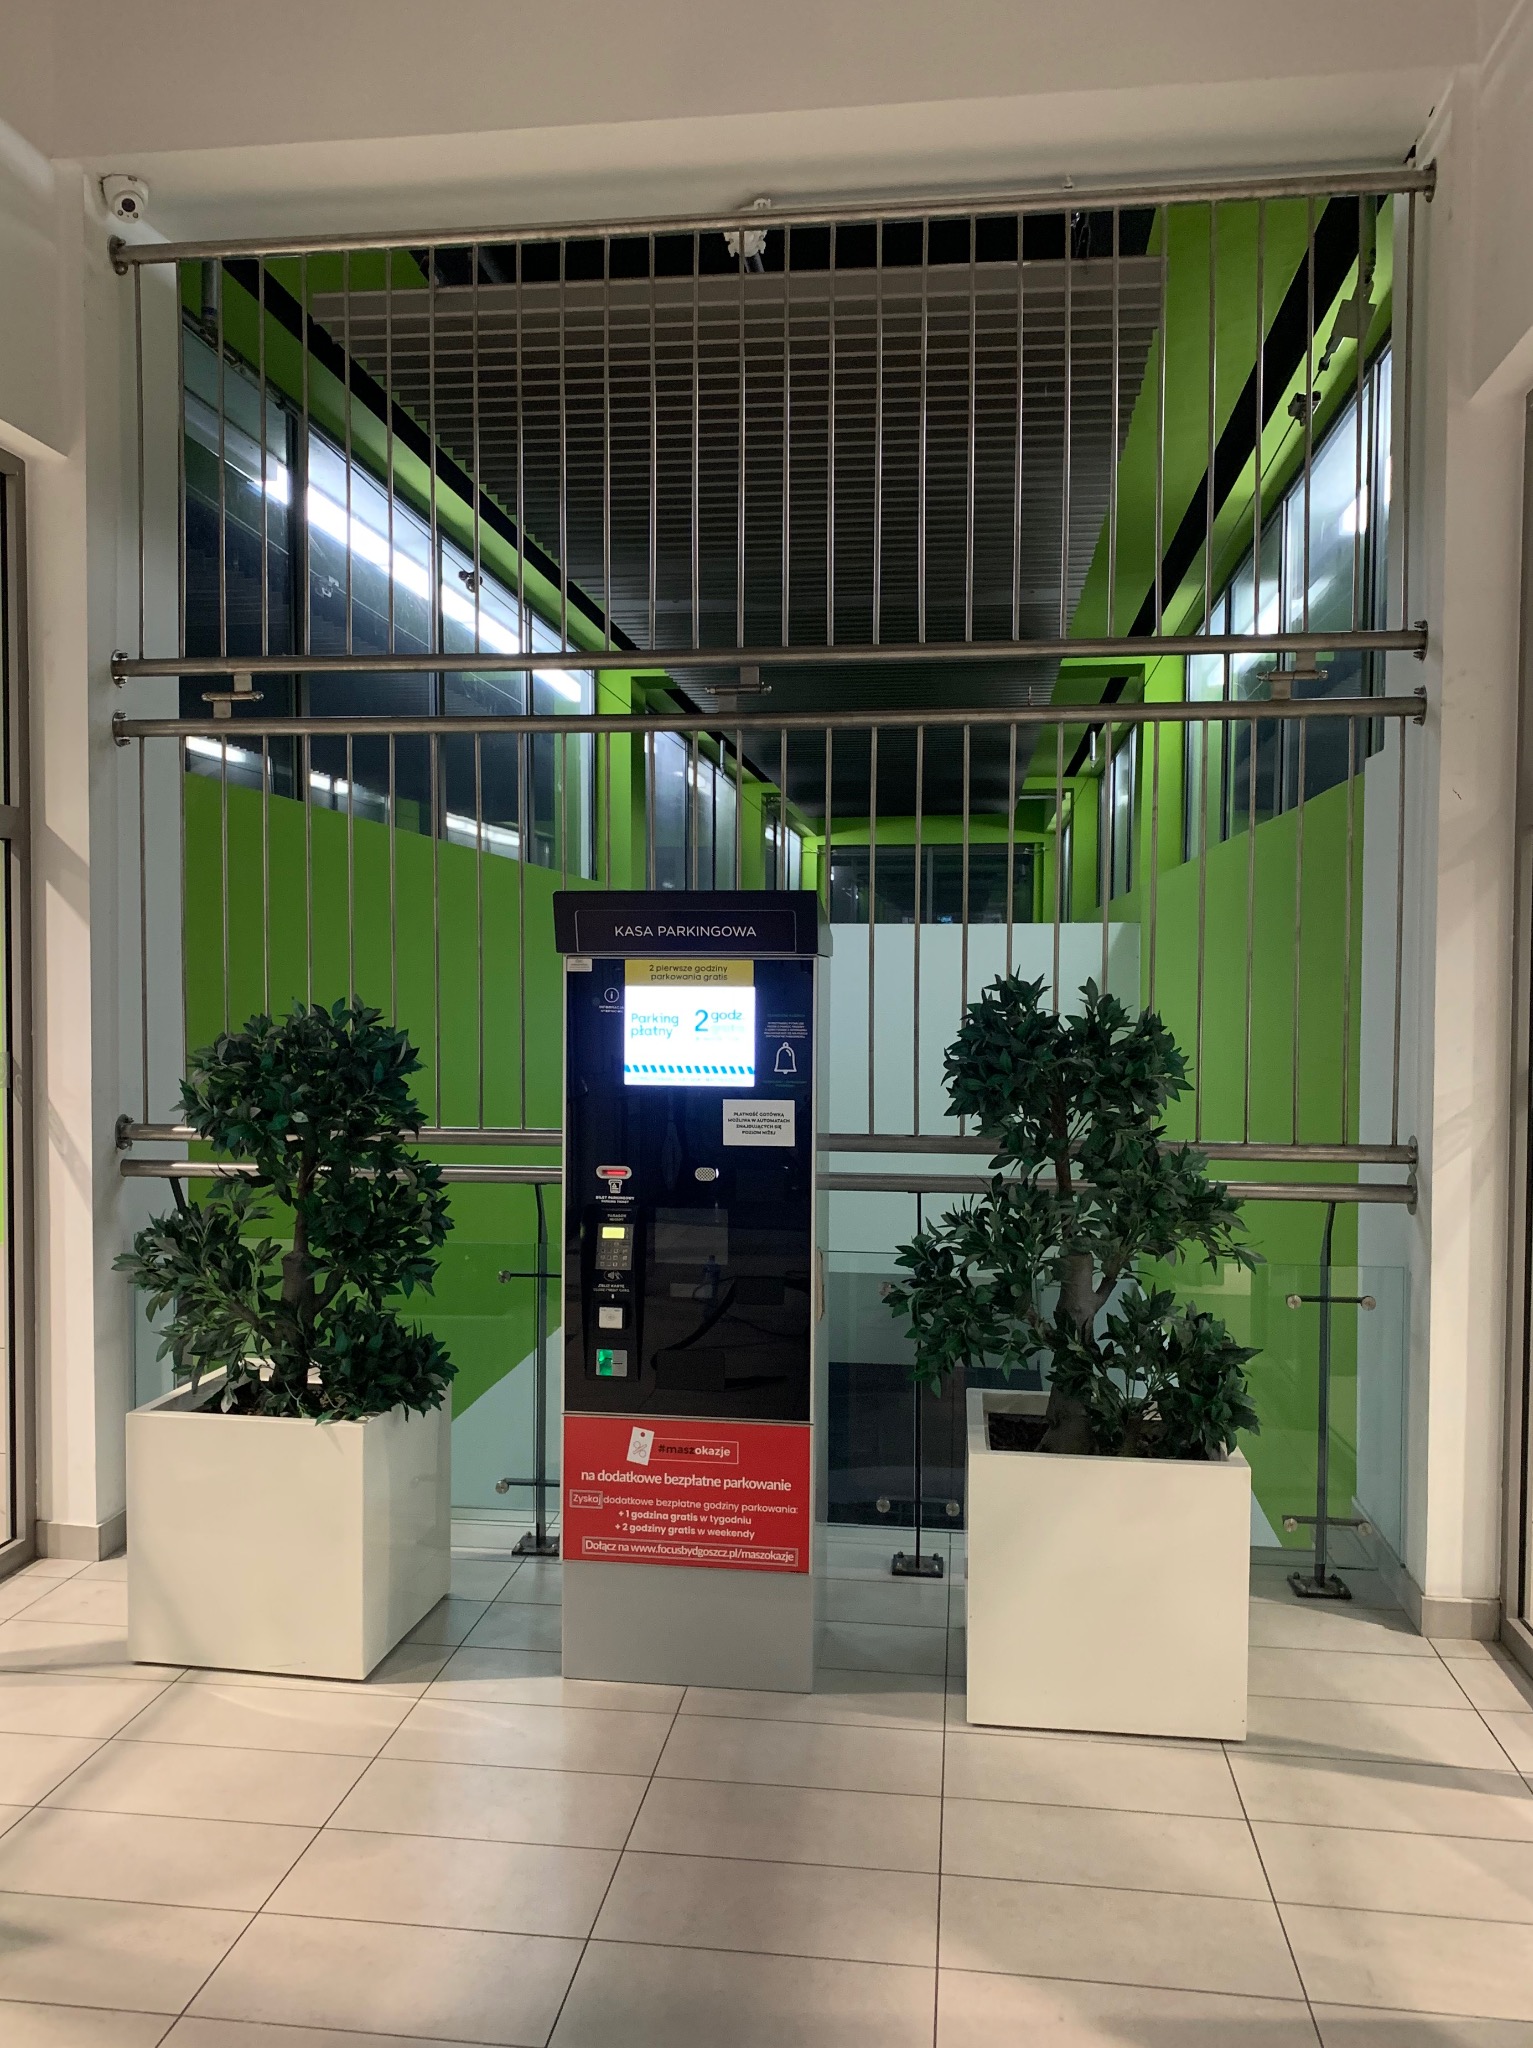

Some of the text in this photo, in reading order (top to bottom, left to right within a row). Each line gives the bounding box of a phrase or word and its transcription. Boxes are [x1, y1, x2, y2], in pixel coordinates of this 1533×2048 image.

[614, 925, 756, 937] KASA PARKINGOWA
[656, 964, 692, 973] pierwsze
[694, 964, 728, 973] godziny
[650, 973, 728, 982] parkowania gratis
[631, 1013, 679, 1026] Parking
[694, 1009, 708, 1032] 2
[631, 1025, 673, 1039] płatny
[657, 1443, 731, 1458] #maszokazje
[581, 1470, 792, 1492] na dodatkowe bezpłatne parkowanie
[572, 1494, 798, 1514] Zyskaj dodatkowe bezpłatne godziny parkowania:
[626, 1510, 630, 1518] 1
[630, 1510, 669, 1522] godzina
[670, 1512, 698, 1523] gratis
[709, 1513, 752, 1526] tygodniu
[622, 1523, 629, 1531] 2
[630, 1524, 667, 1535] godziny
[667, 1526, 696, 1536] gratis
[697, 1528, 706, 1536] w
[707, 1527, 755, 1540] weekendy
[585, 1539, 617, 1553] Dołącz
[630, 1543, 795, 1562] www.focusbydgoszcz.pl/maszokazje
